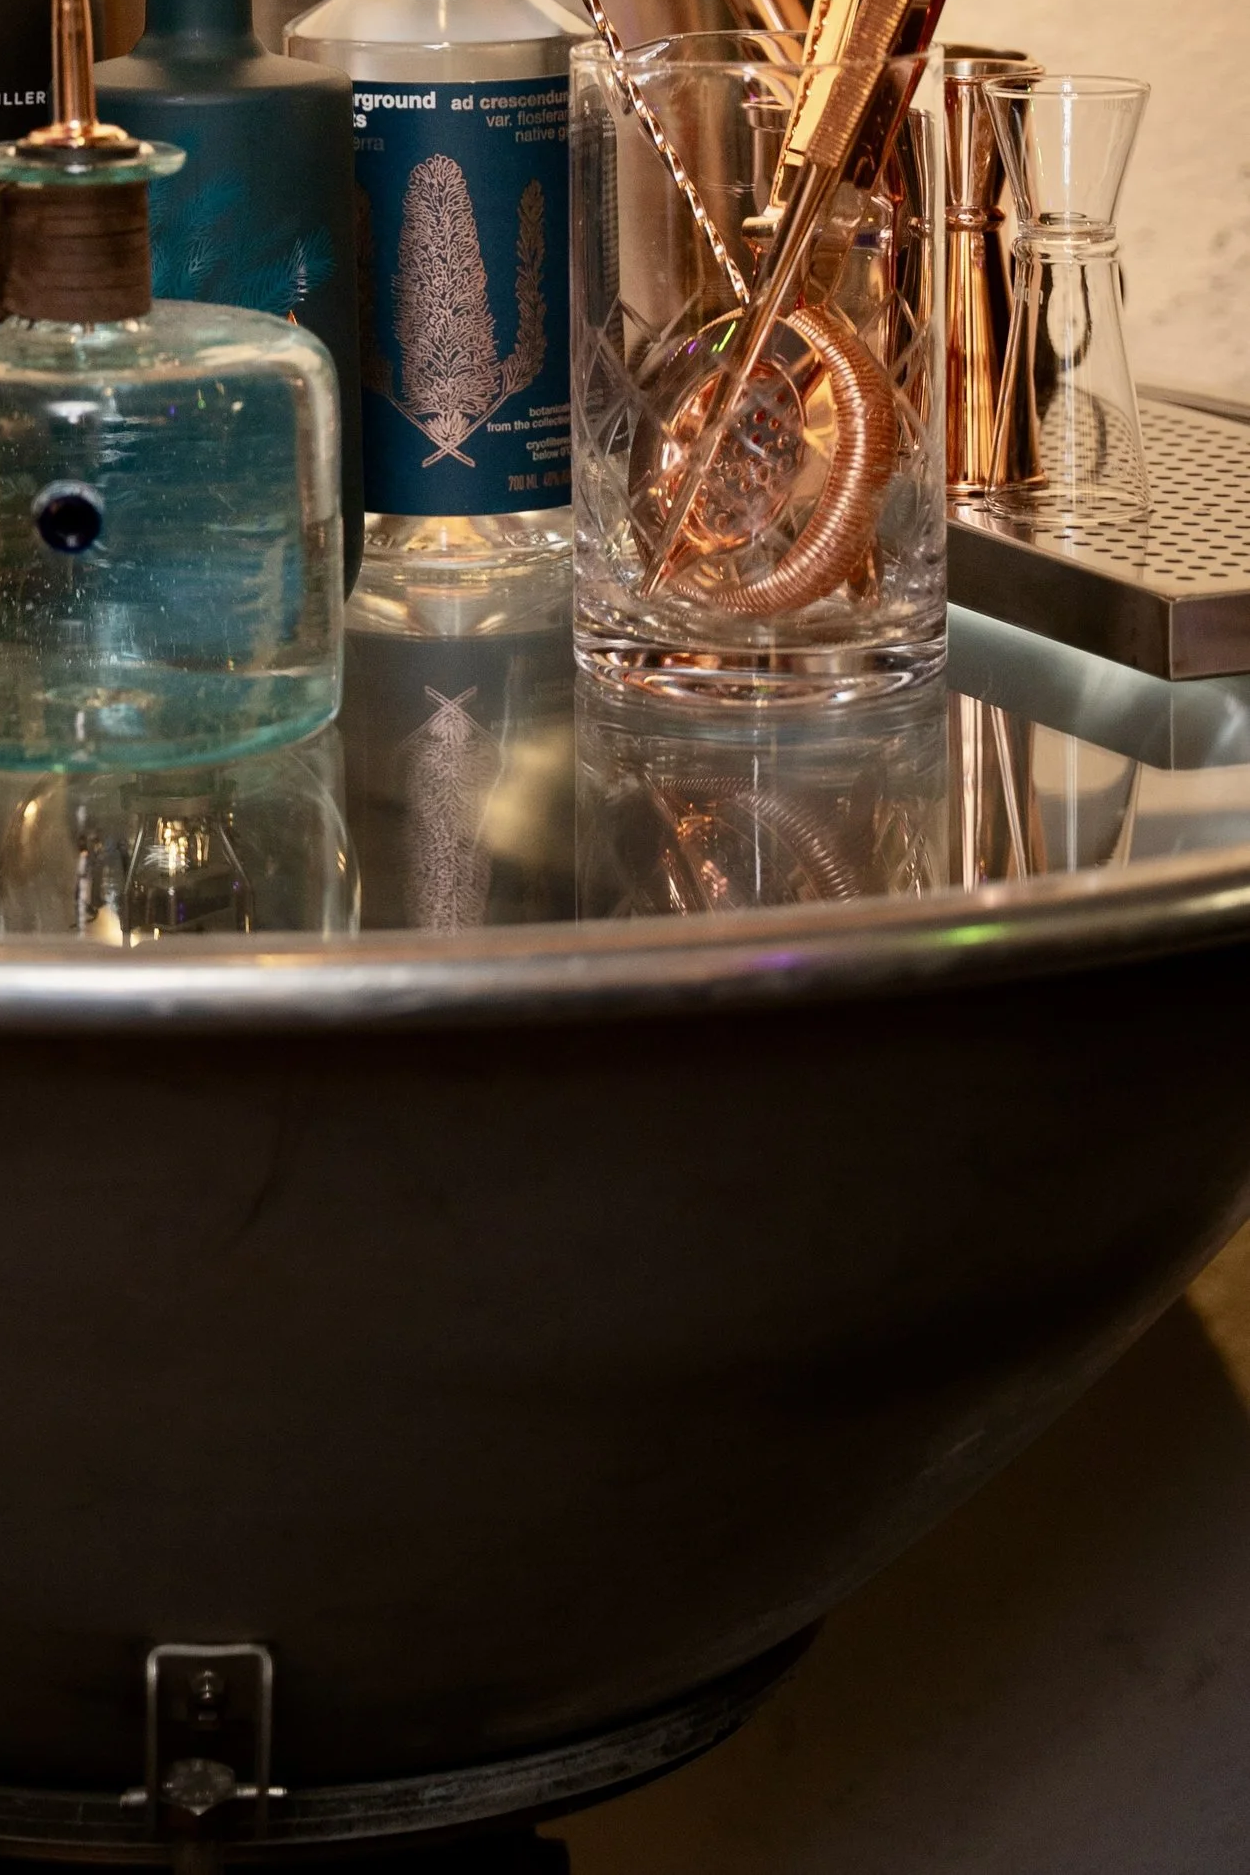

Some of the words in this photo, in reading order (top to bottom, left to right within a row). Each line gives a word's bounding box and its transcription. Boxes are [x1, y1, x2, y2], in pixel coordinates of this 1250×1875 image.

[353, 90, 437, 112] rground
[450, 95, 474, 110] ad
[515, 126, 555, 143] native
[486, 420, 512, 432] from
[513, 419, 530, 430] the
